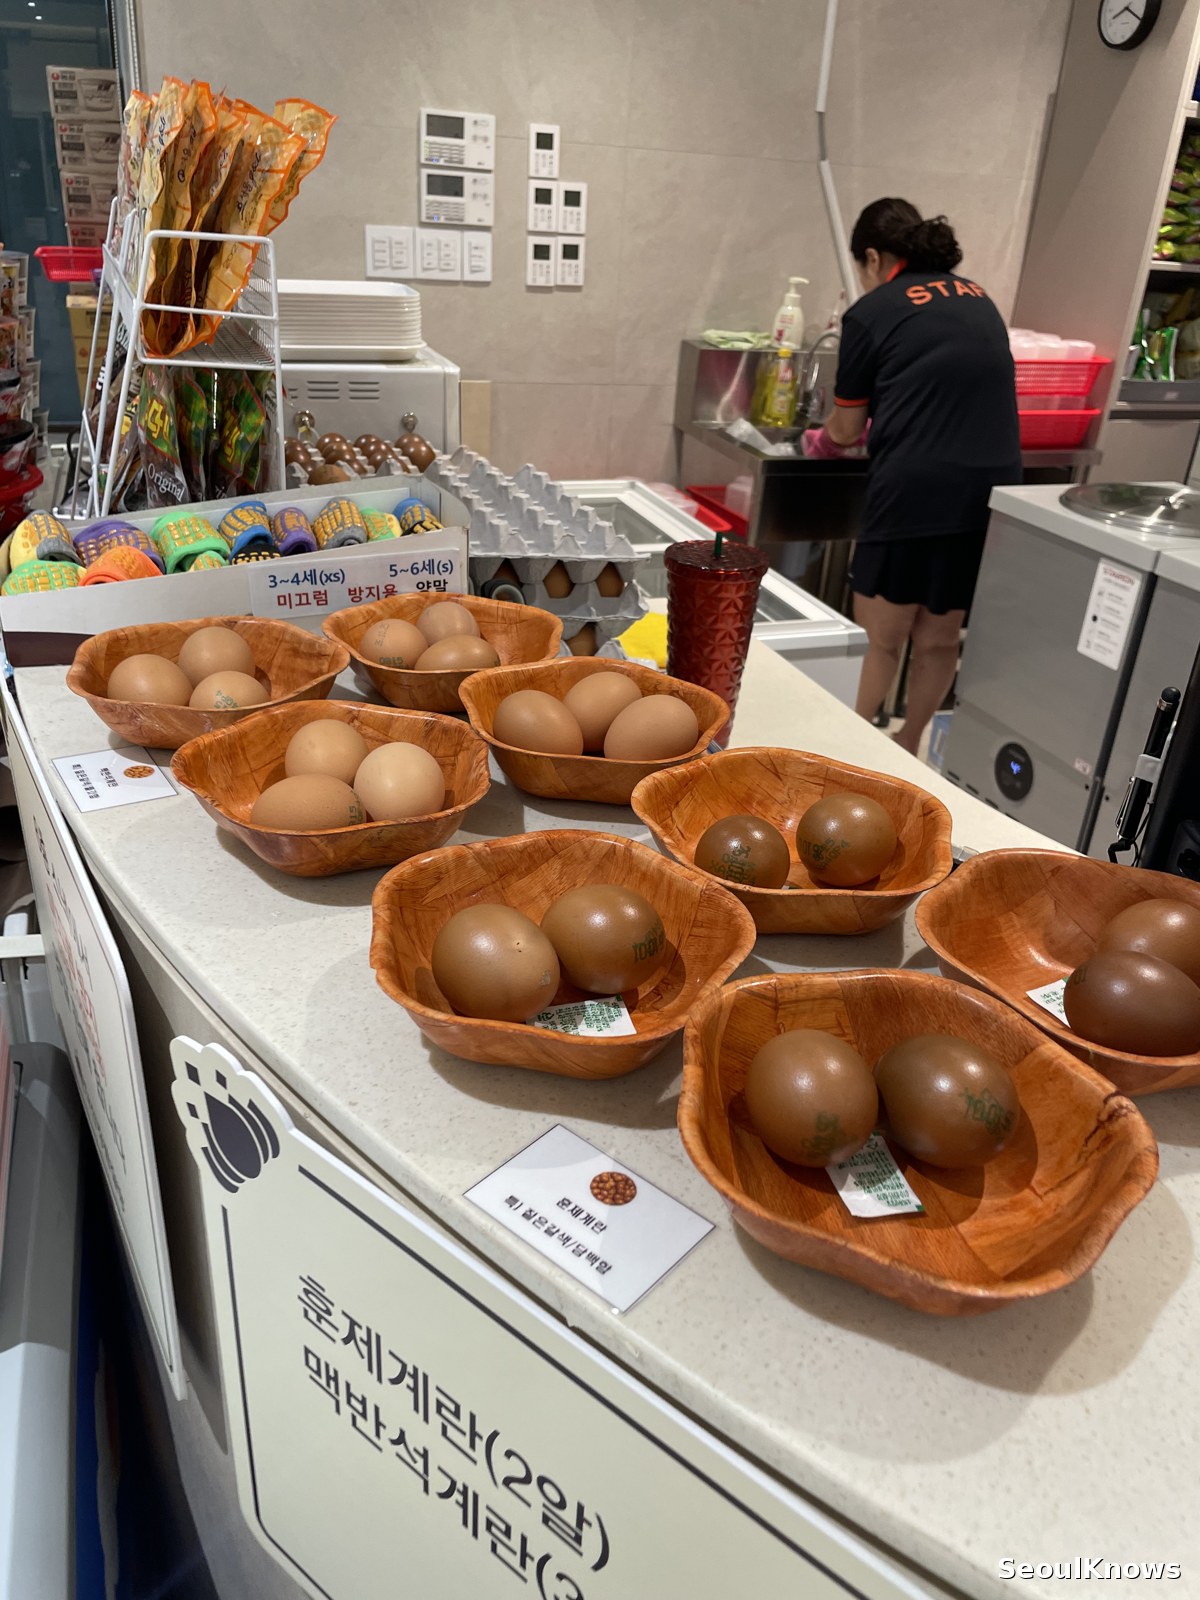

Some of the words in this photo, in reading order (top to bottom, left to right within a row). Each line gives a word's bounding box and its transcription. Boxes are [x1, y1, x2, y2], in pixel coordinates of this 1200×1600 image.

[148, 463, 185, 502] Original
[268, 568, 345, 588] 3~4세(xs)
[389, 558, 454, 577] 5~6세(s)
[277, 589, 329, 610] 미끄럼
[347, 583, 398, 603] 방지용
[415, 578, 449, 593] 양말
[297, 1274, 610, 1572] 훈제계란(2알)
